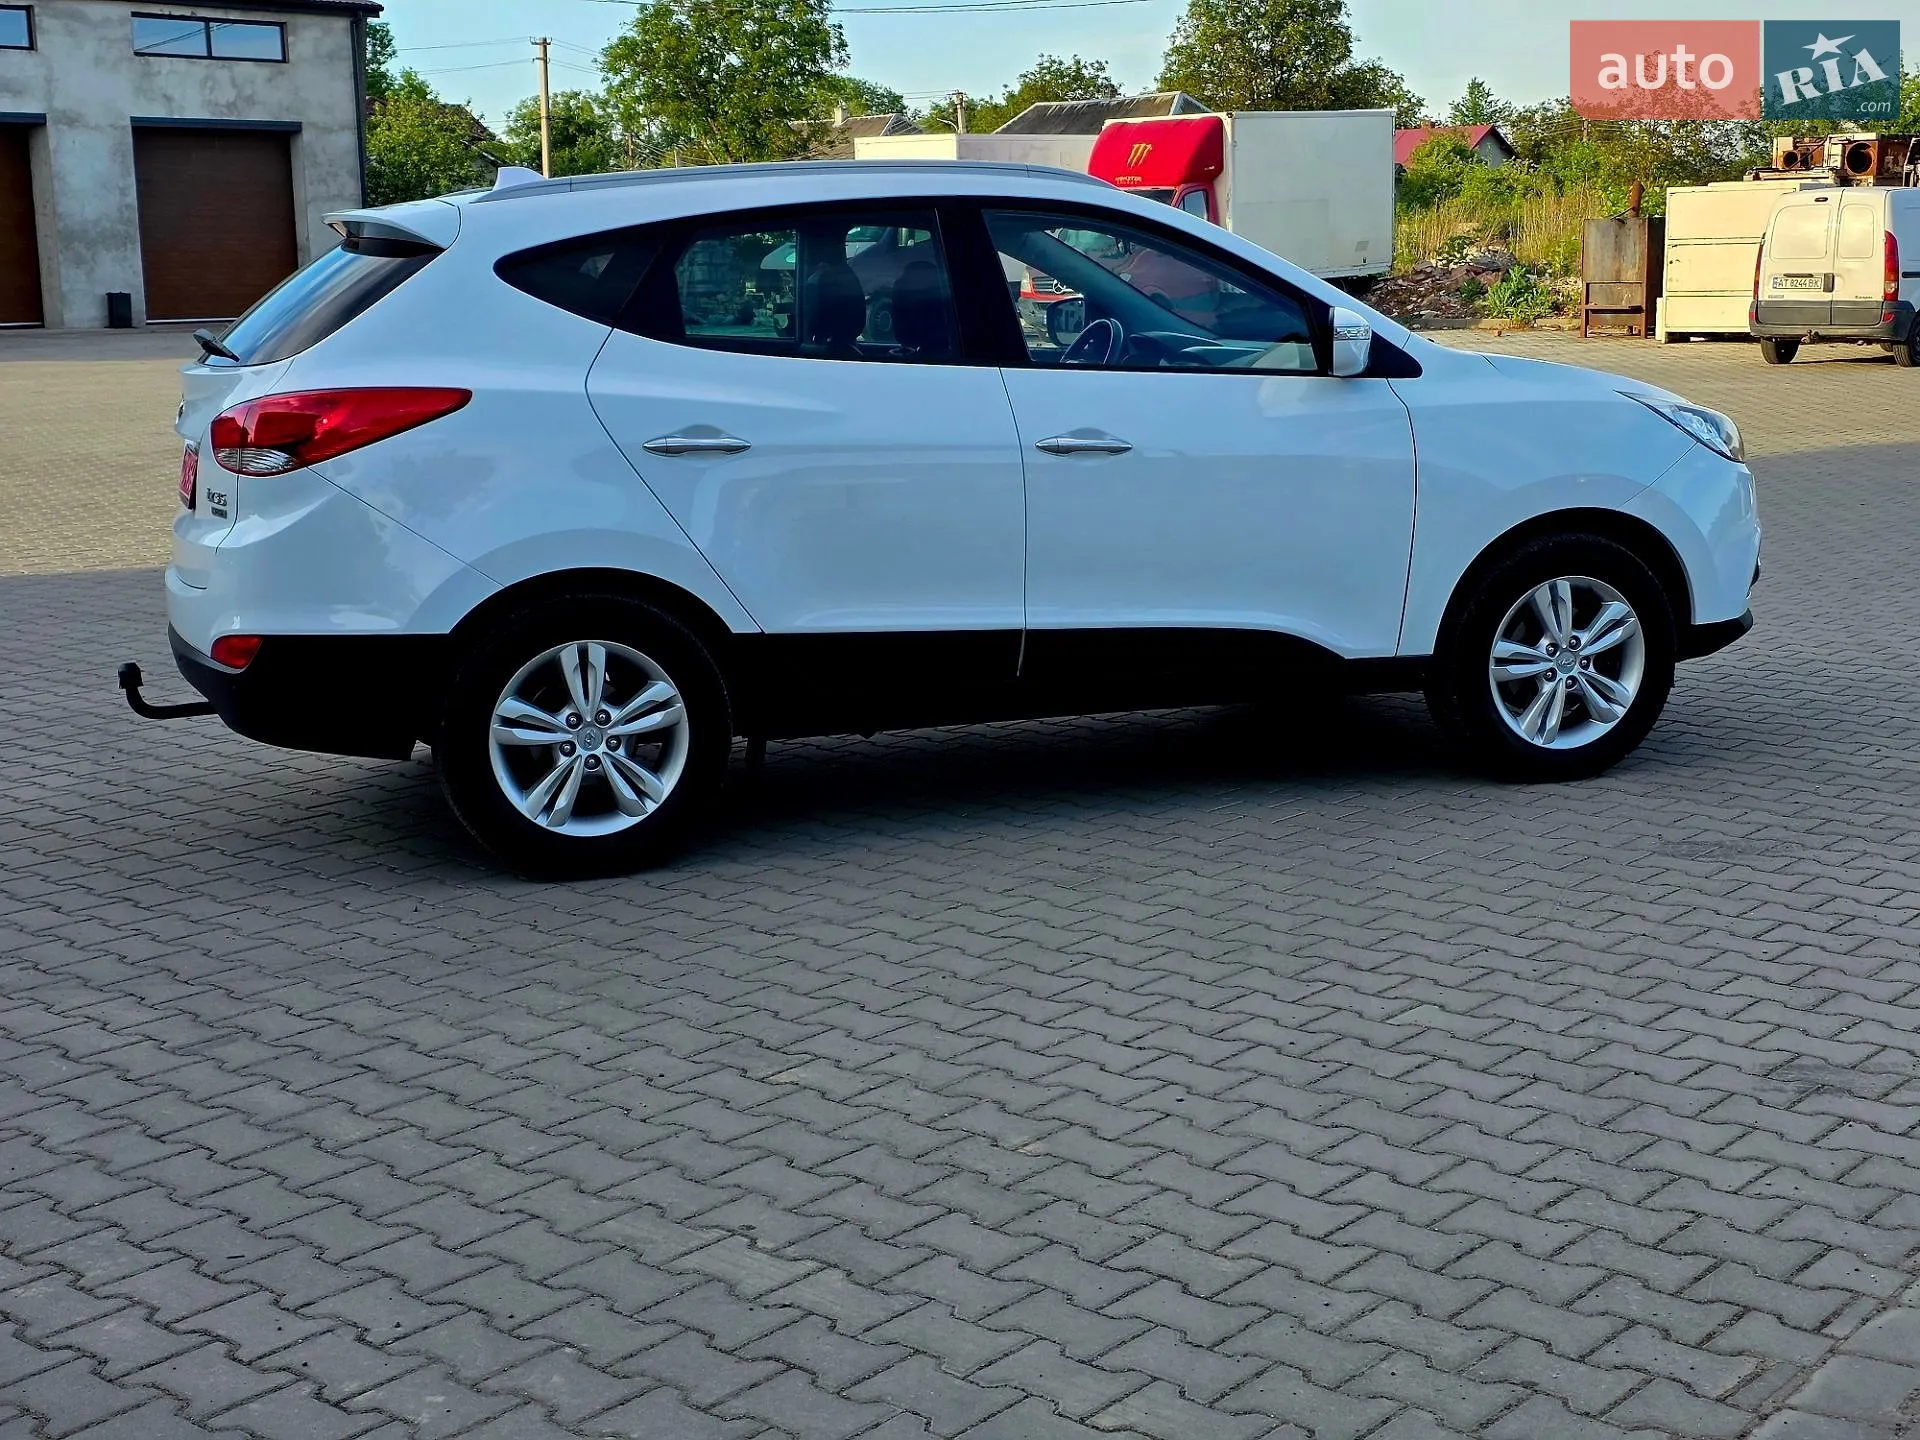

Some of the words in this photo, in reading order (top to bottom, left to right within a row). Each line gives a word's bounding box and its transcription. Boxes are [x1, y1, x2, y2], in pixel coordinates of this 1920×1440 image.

[1778, 279, 1789, 287] AT
[1790, 279, 1807, 287] 8244
[1808, 279, 1819, 287] BK
